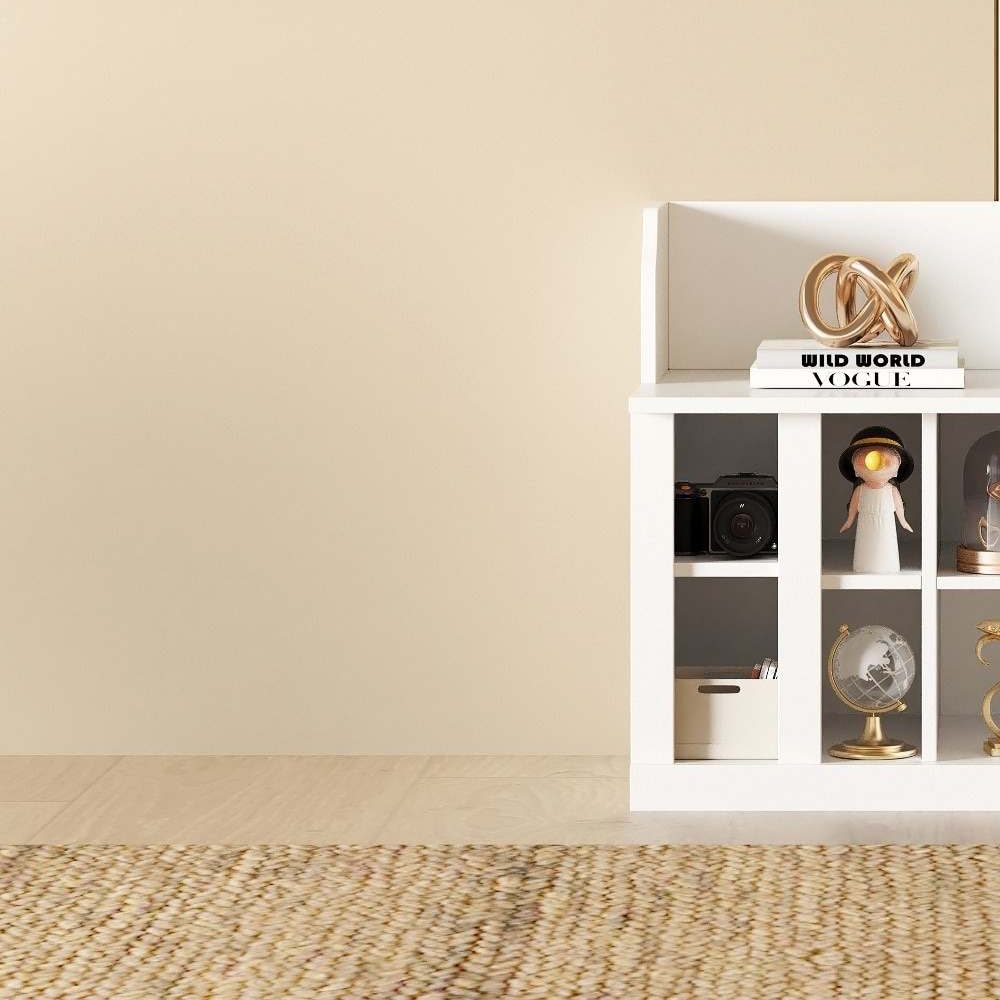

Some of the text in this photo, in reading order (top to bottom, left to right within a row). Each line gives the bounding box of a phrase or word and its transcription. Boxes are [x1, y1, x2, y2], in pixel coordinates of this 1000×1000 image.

[801, 354, 925, 367] WILD WORLD
[812, 372, 911, 387] VOGUE
